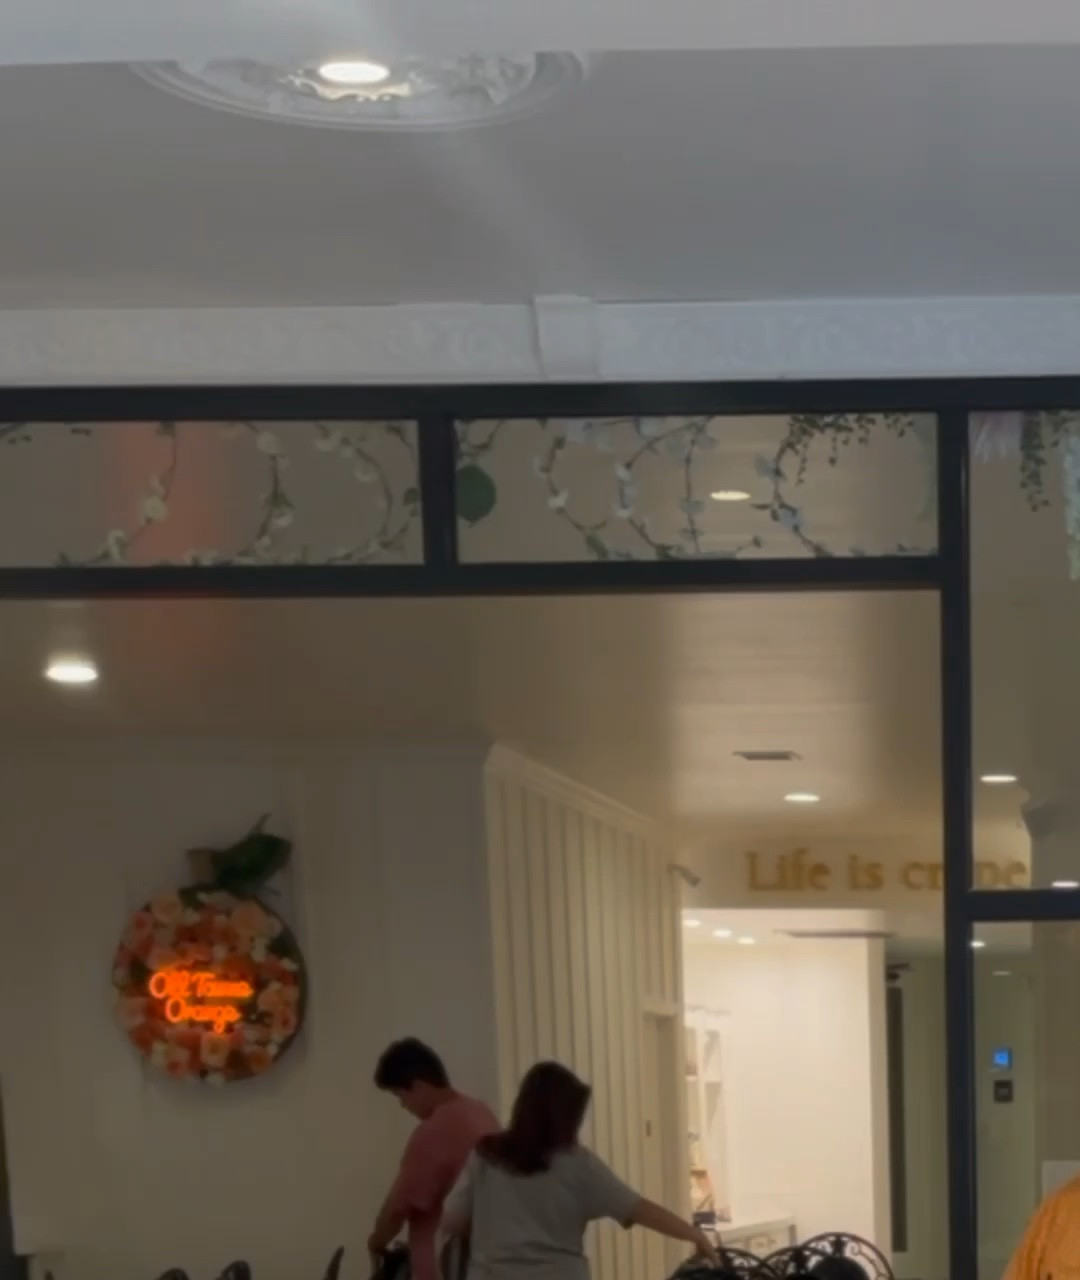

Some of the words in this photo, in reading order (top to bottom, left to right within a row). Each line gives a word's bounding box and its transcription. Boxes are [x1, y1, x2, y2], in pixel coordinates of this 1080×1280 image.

[745, 848, 831, 891] Life
[848, 854, 883, 890] is
[899, 859, 1028, 891] crpe
[148, 970, 191, 998] Old
[165, 996, 241, 1034] Orange
